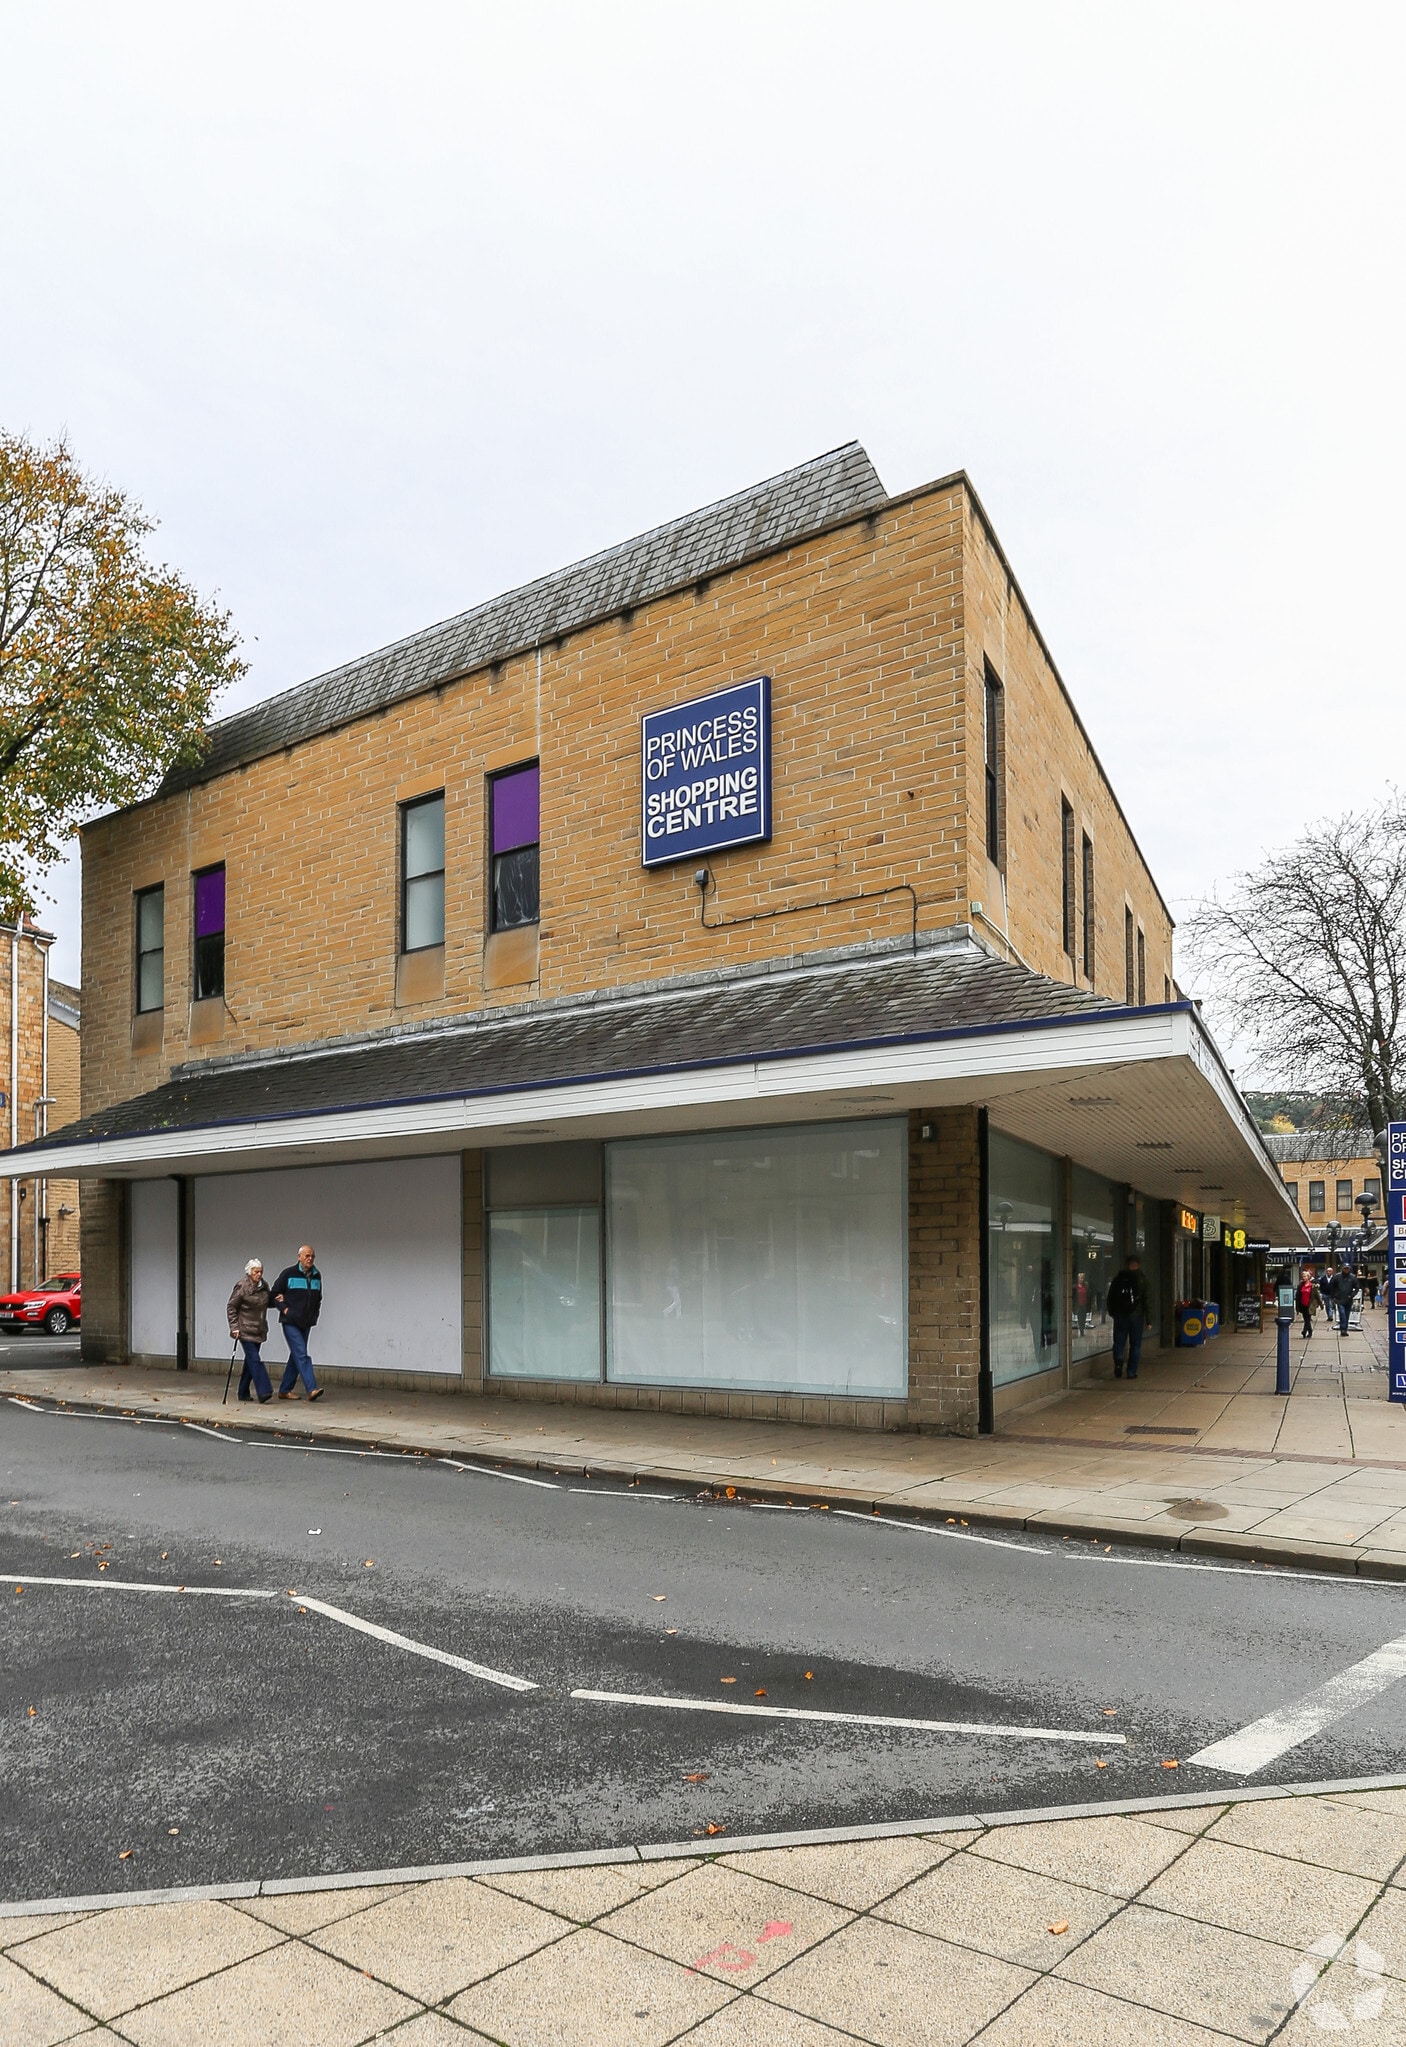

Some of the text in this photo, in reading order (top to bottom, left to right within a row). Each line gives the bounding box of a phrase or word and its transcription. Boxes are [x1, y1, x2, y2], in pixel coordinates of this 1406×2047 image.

[647, 706, 758, 760] PRINCESS
[647, 729, 758, 781] OF WALES
[647, 766, 758, 817] SHOPPING
[647, 789, 758, 839] CENTRE
